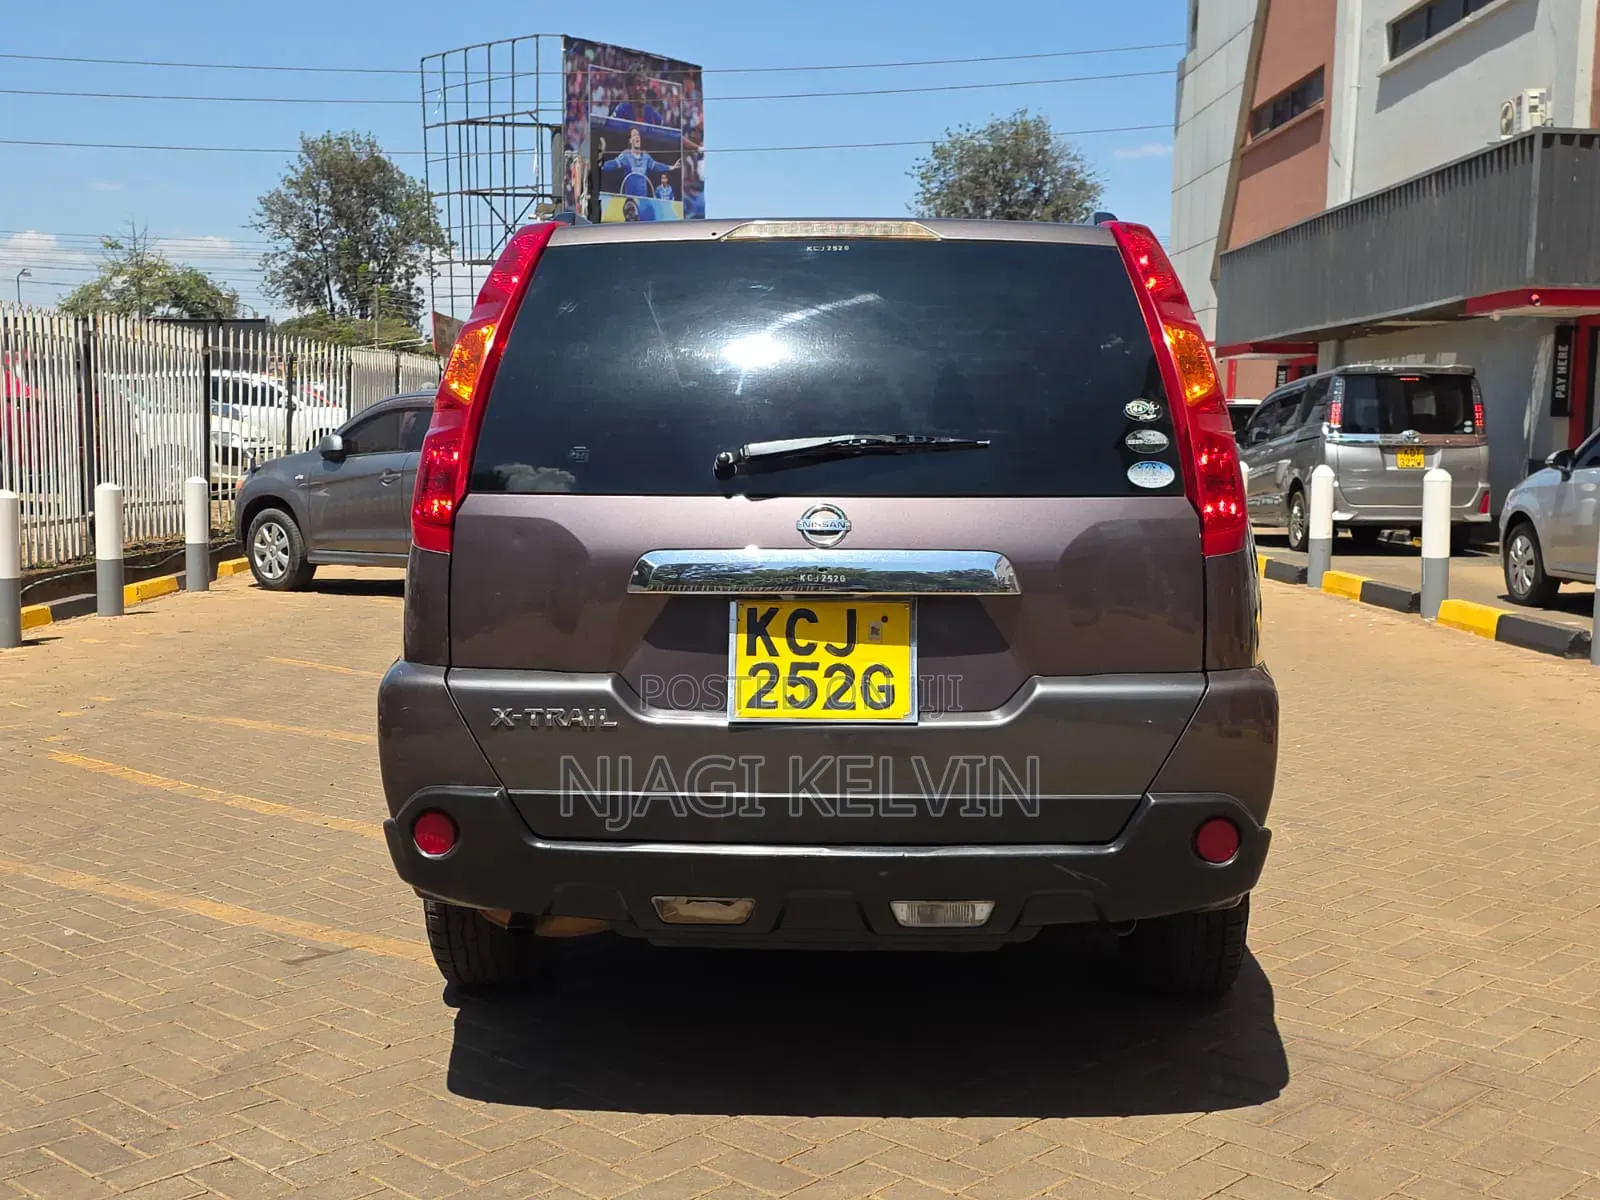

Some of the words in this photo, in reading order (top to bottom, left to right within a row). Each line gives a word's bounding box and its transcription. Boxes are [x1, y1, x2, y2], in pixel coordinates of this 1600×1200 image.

[1556, 344, 1569, 375] HERE
[1555, 377, 1567, 399] PAY
[802, 521, 846, 529] NISSAN
[745, 606, 857, 658] KCJ
[746, 661, 896, 711] 252G
[489, 707, 619, 727] X-TRAIL
